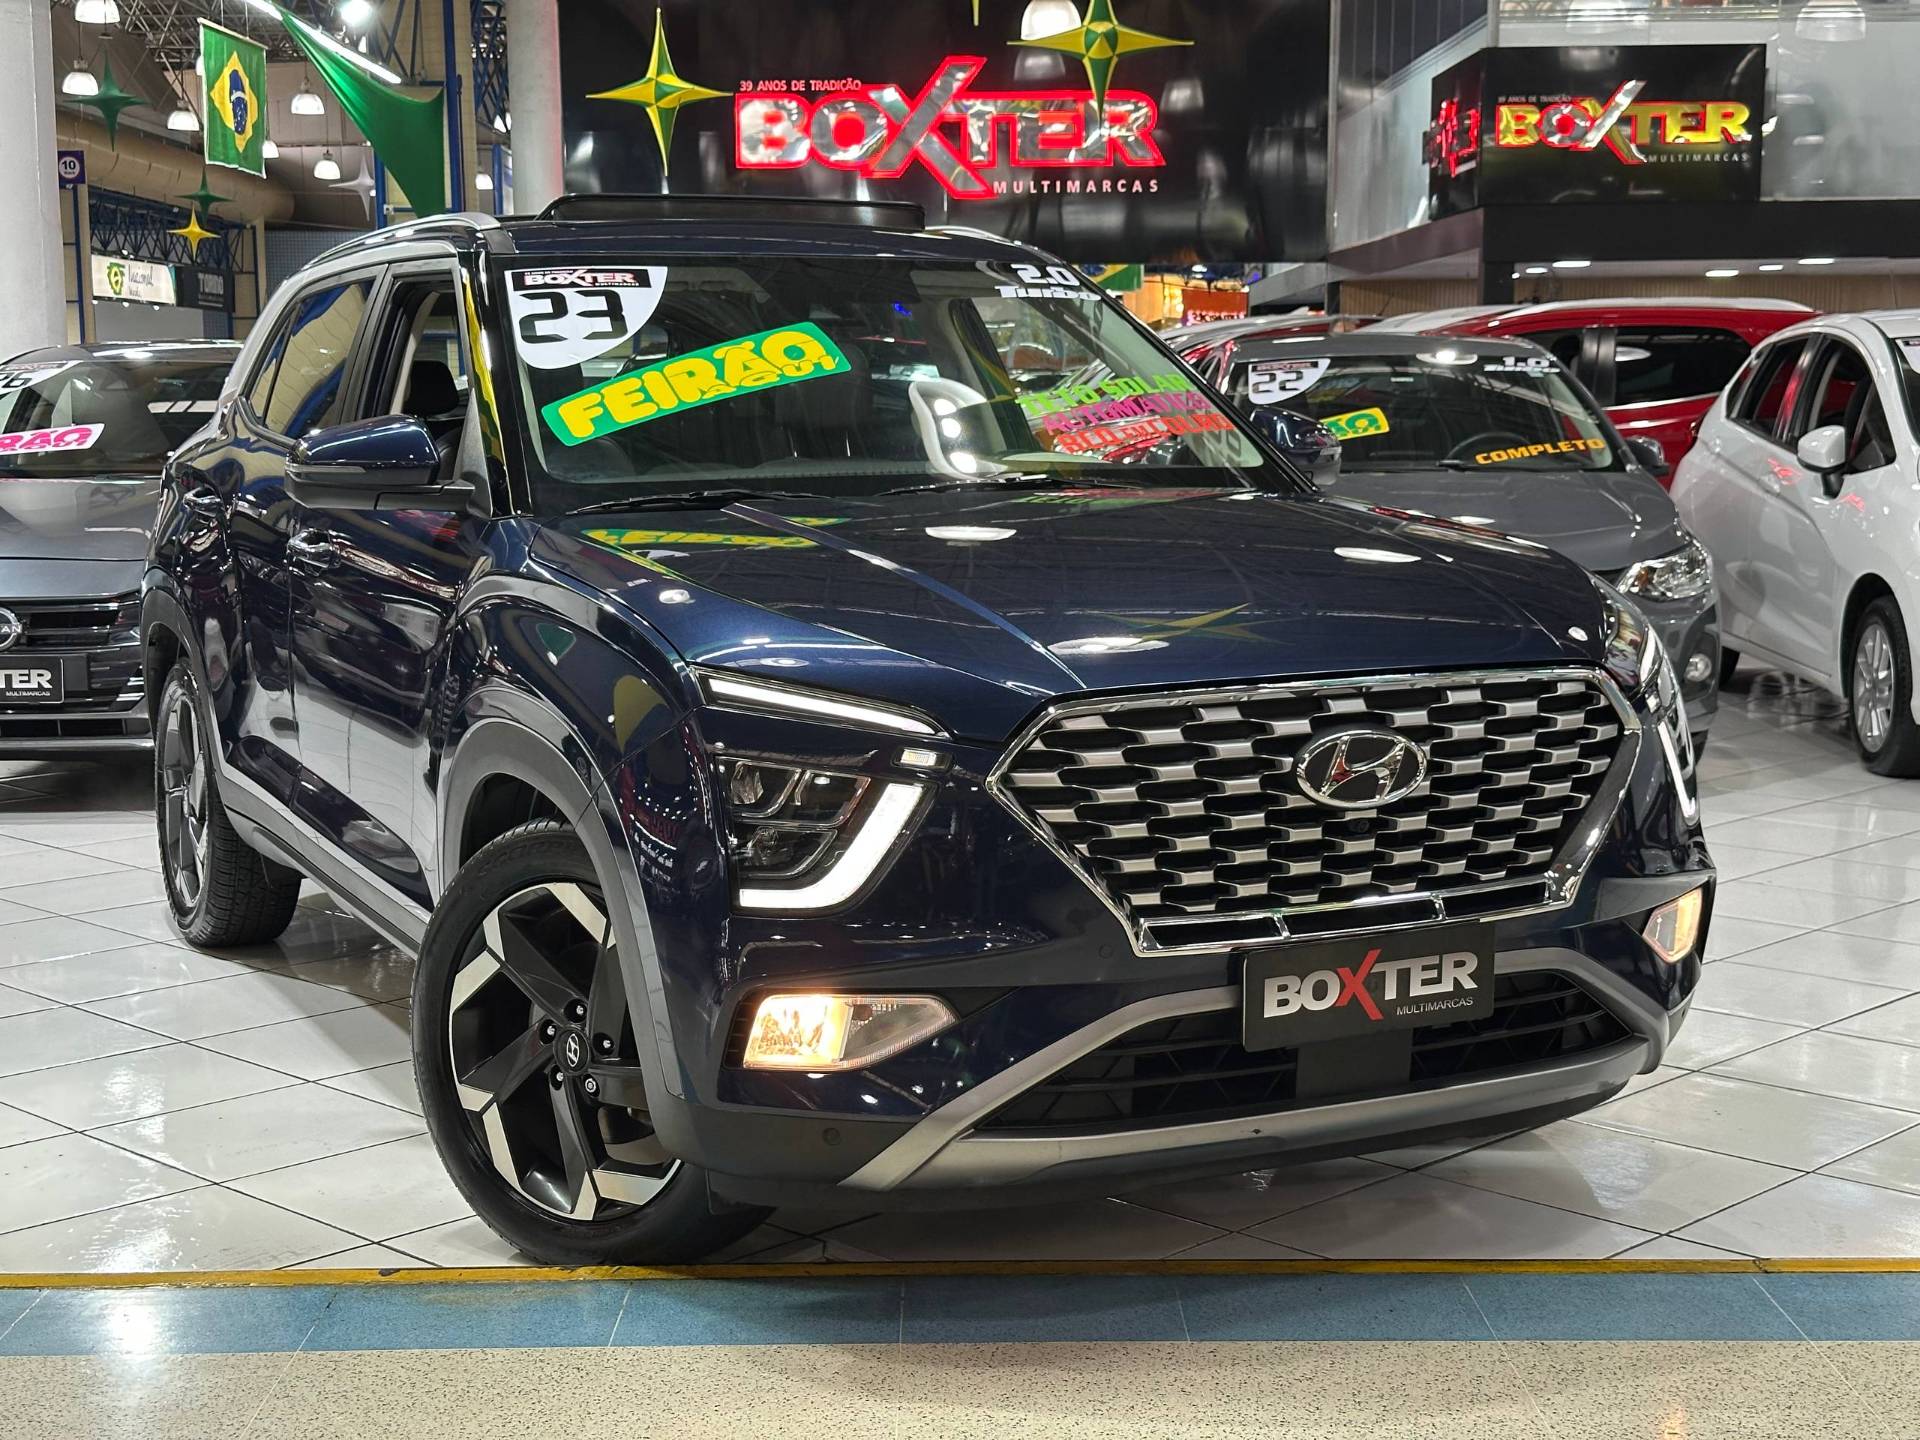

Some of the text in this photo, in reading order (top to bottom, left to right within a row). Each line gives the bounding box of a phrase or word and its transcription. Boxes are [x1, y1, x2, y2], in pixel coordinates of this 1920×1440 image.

[739, 78, 862, 92] 39 ANOS DE TRADIÇÃO
[735, 55, 1166, 199] BOXTER
[1495, 80, 1753, 165] BOXTER
[62, 160, 76, 170] 10
[1648, 152, 1750, 164] MULTIMARCAS
[993, 178, 1160, 194] MULTIMARCAS
[524, 269, 636, 287] BOXTER
[1010, 263, 1080, 287] 2.0
[994, 285, 1102, 301] Turbo
[519, 289, 629, 344] 23
[1503, 356, 1549, 368] 1.0
[558, 331, 826, 438] FEIRÃO
[1252, 370, 1303, 393] 22
[1016, 374, 1194, 416] TETO SOLAR
[1475, 438, 1606, 465] COMPLETO
[1264, 948, 1479, 1021] BOXTER
[1396, 996, 1474, 1016] MULTIMARCAS
